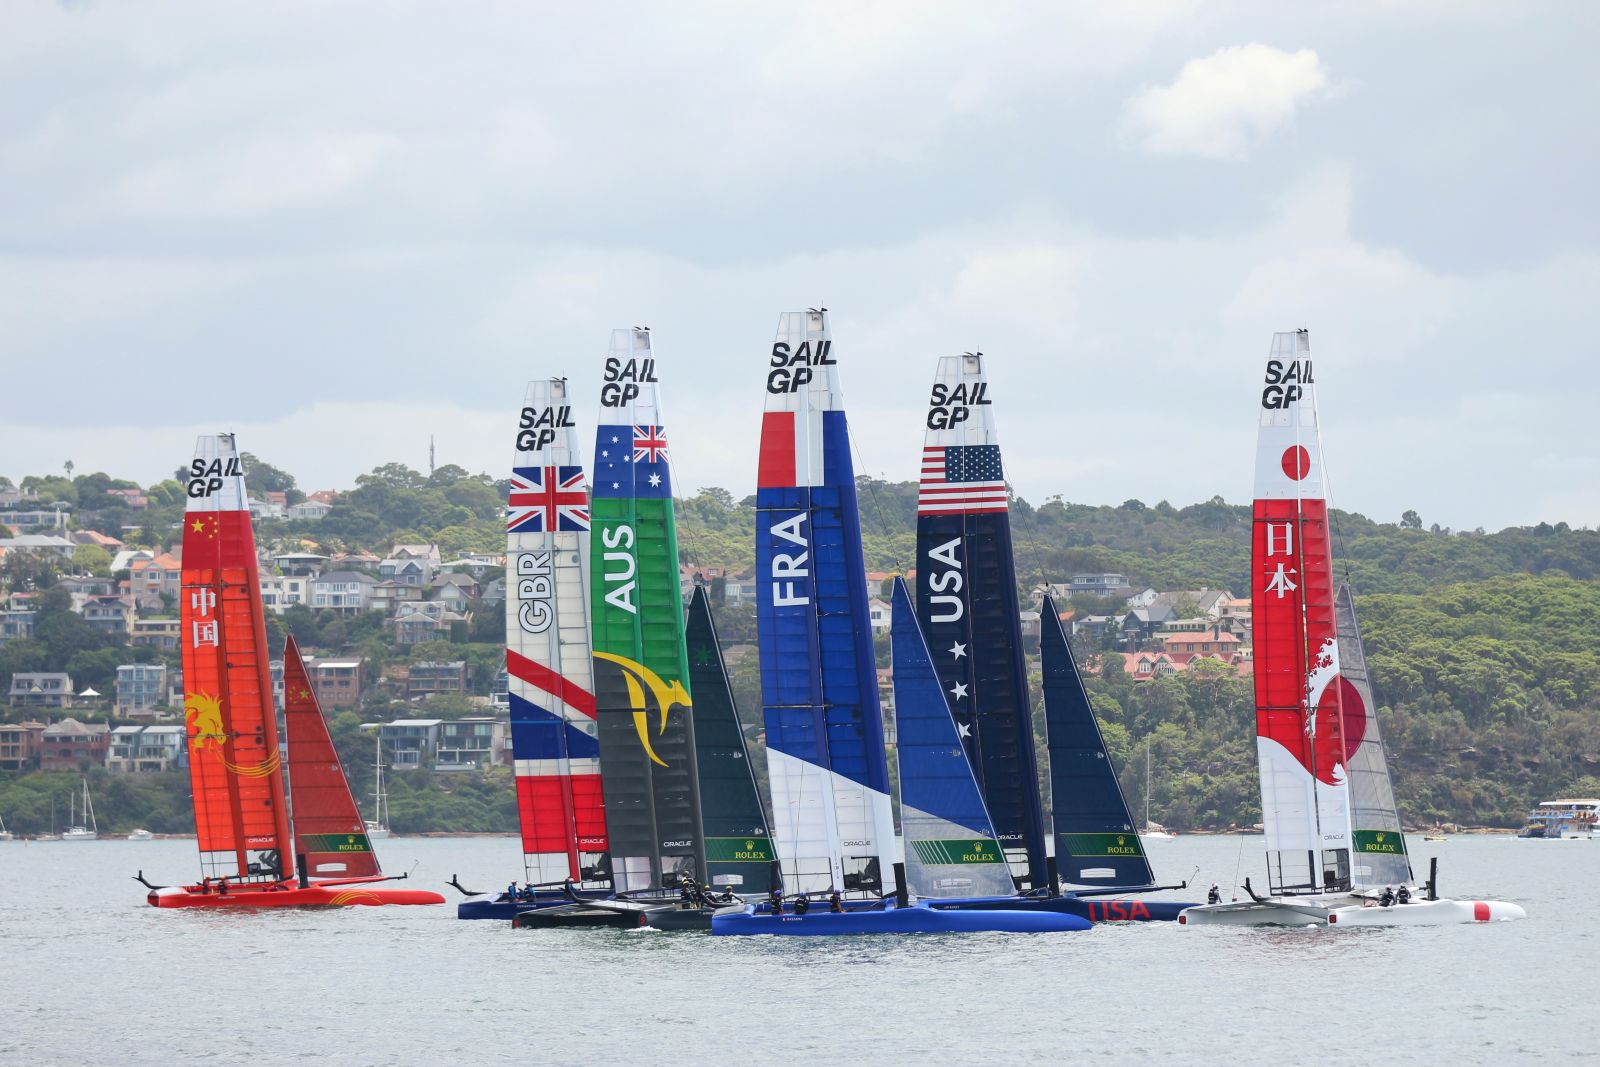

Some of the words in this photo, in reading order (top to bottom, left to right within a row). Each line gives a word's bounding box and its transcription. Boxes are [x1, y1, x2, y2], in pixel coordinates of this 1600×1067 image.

[771, 341, 836, 367] SAIL
[604, 358, 657, 382] SAIL
[767, 367, 812, 393] GP
[1266, 360, 1314, 384] SAIL
[601, 383, 638, 407] GP
[931, 382, 991, 406] SAIL
[1262, 385, 1303, 409] GP
[519, 406, 575, 429] SAIL
[927, 406, 968, 430] GP
[517, 429, 555, 451] GP
[191, 458, 244, 477] SAIL
[188, 478, 223, 498] GP
[603, 525, 636, 614] AUS
[771, 512, 809, 607] FRA
[1263, 522, 1297, 599] 日本
[519, 551, 554, 633] GBR
[929, 537, 963, 623] USA
[191, 587, 219, 649] 中国
[735, 851, 766, 859] ROLEX
[963, 853, 995, 861] ROLEX
[1107, 846, 1135, 854] ROLEX
[1365, 843, 1395, 852] ROLEX
[1088, 900, 1151, 921] USA
